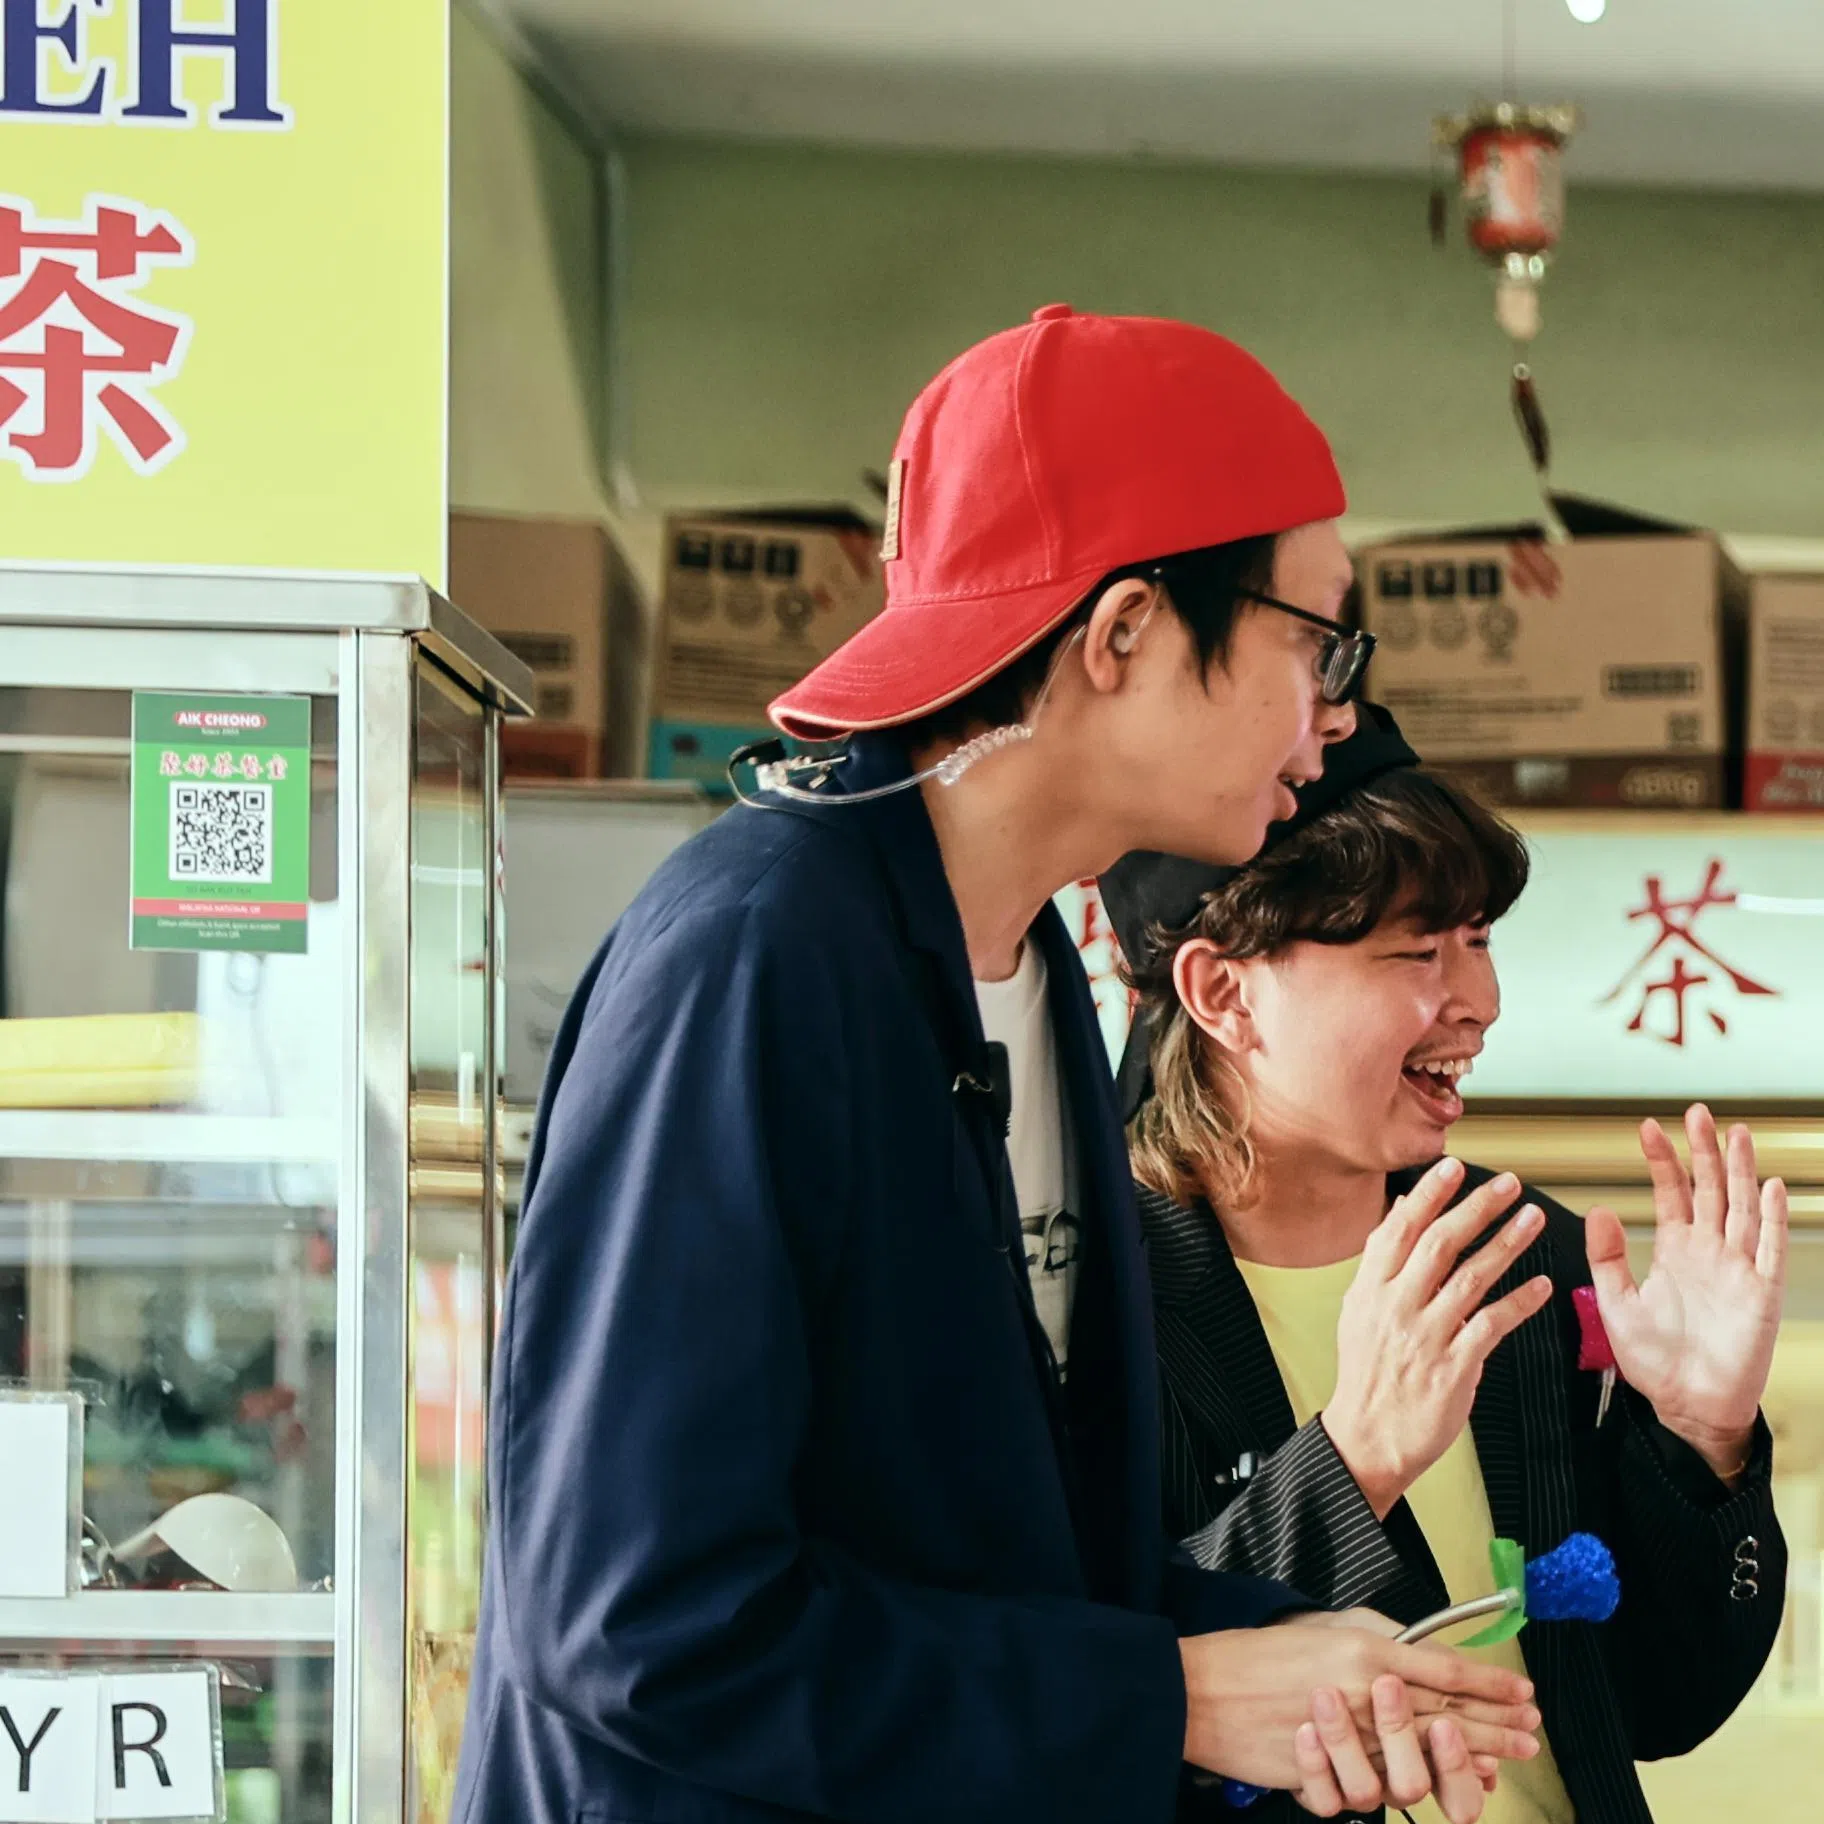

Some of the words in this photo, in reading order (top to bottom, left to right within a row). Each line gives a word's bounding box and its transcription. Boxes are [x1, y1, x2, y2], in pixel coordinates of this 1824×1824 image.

[0, 206, 182, 469] 茶
[178, 711, 201, 725] AIK
[204, 713, 261, 727] CHEONG
[0, 1702, 172, 1792] YR
